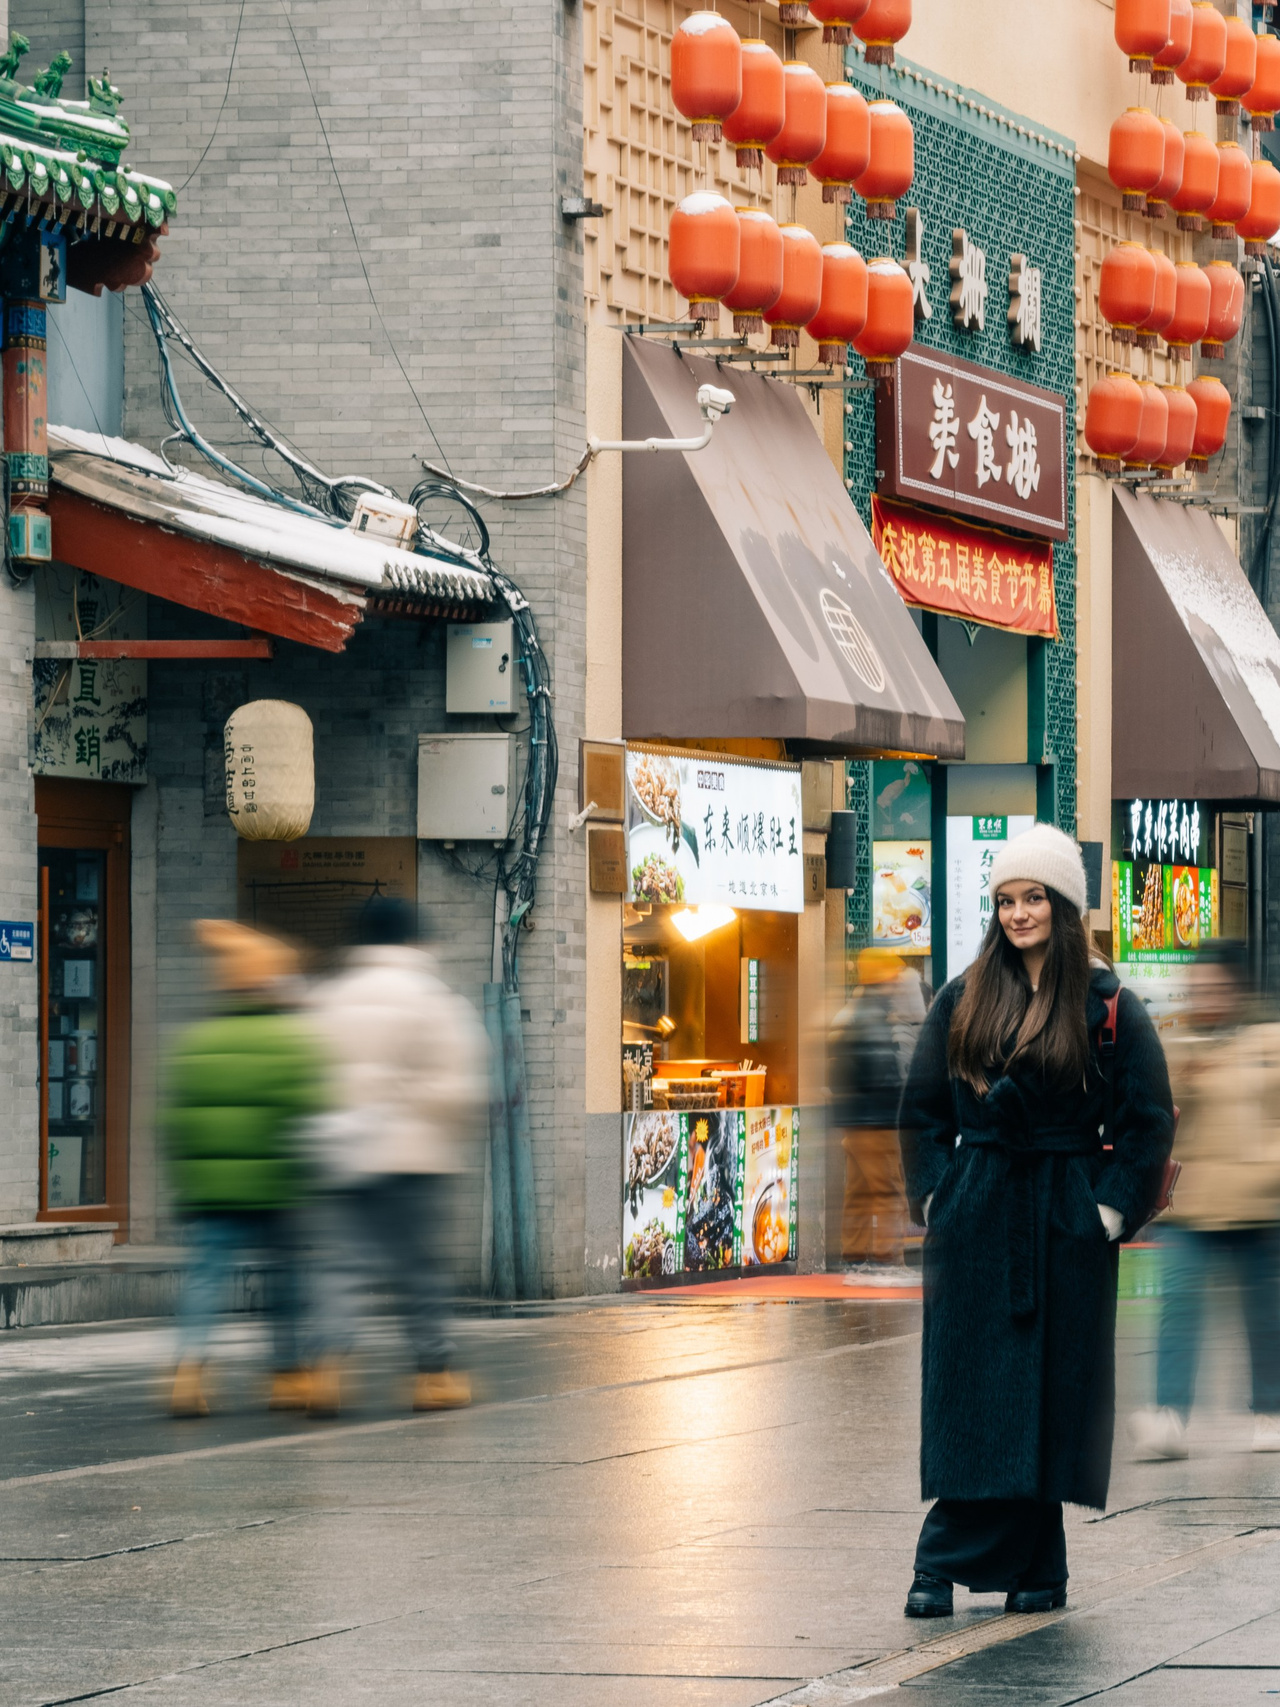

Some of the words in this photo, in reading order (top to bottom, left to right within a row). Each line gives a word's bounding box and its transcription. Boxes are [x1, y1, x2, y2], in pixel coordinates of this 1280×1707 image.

[929, 379, 1041, 500] 美食城
[880, 522, 1052, 615] 庆祝第五届美食节开幕
